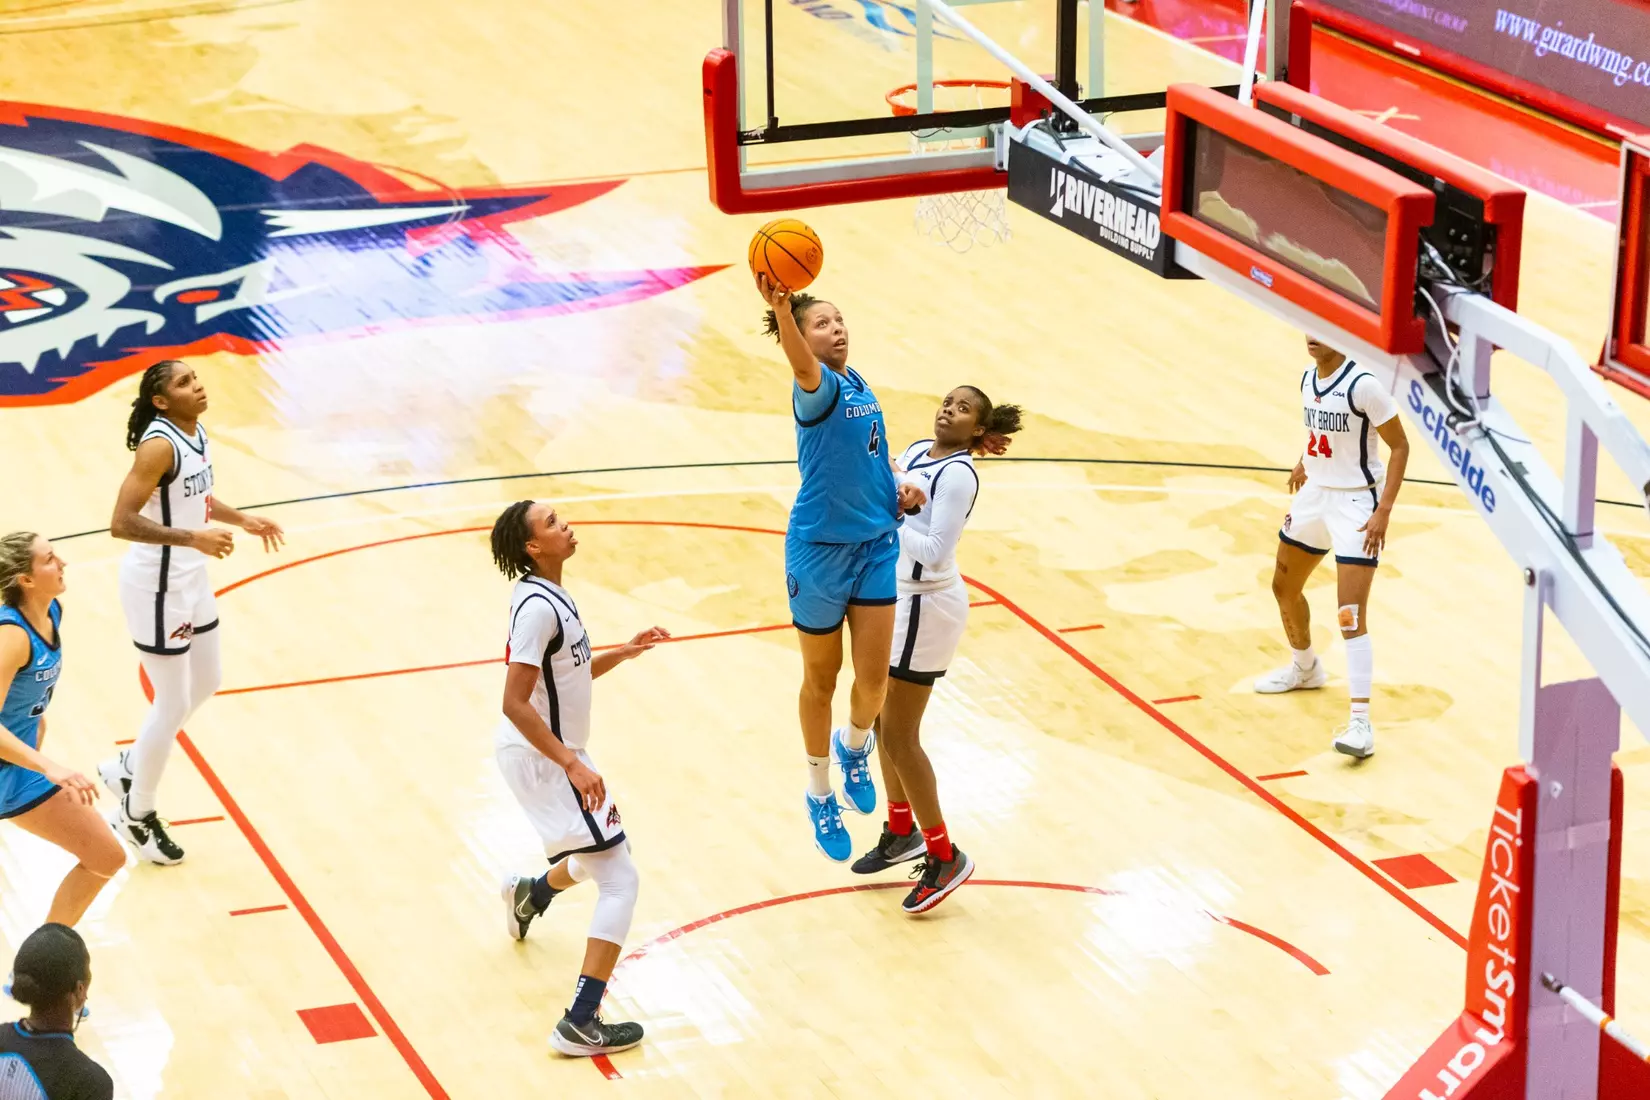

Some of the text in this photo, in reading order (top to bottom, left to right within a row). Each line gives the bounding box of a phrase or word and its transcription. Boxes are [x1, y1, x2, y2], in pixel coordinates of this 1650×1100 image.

[1065, 173, 1160, 250] RIVERHEAD
[1099, 226, 1155, 261] BUILDING SUPPLY
[868, 420, 880, 458] 4
[1318, 410, 1350, 433] BROOK
[1307, 431, 1333, 458] 24
[1408, 379, 1496, 513] Schelde
